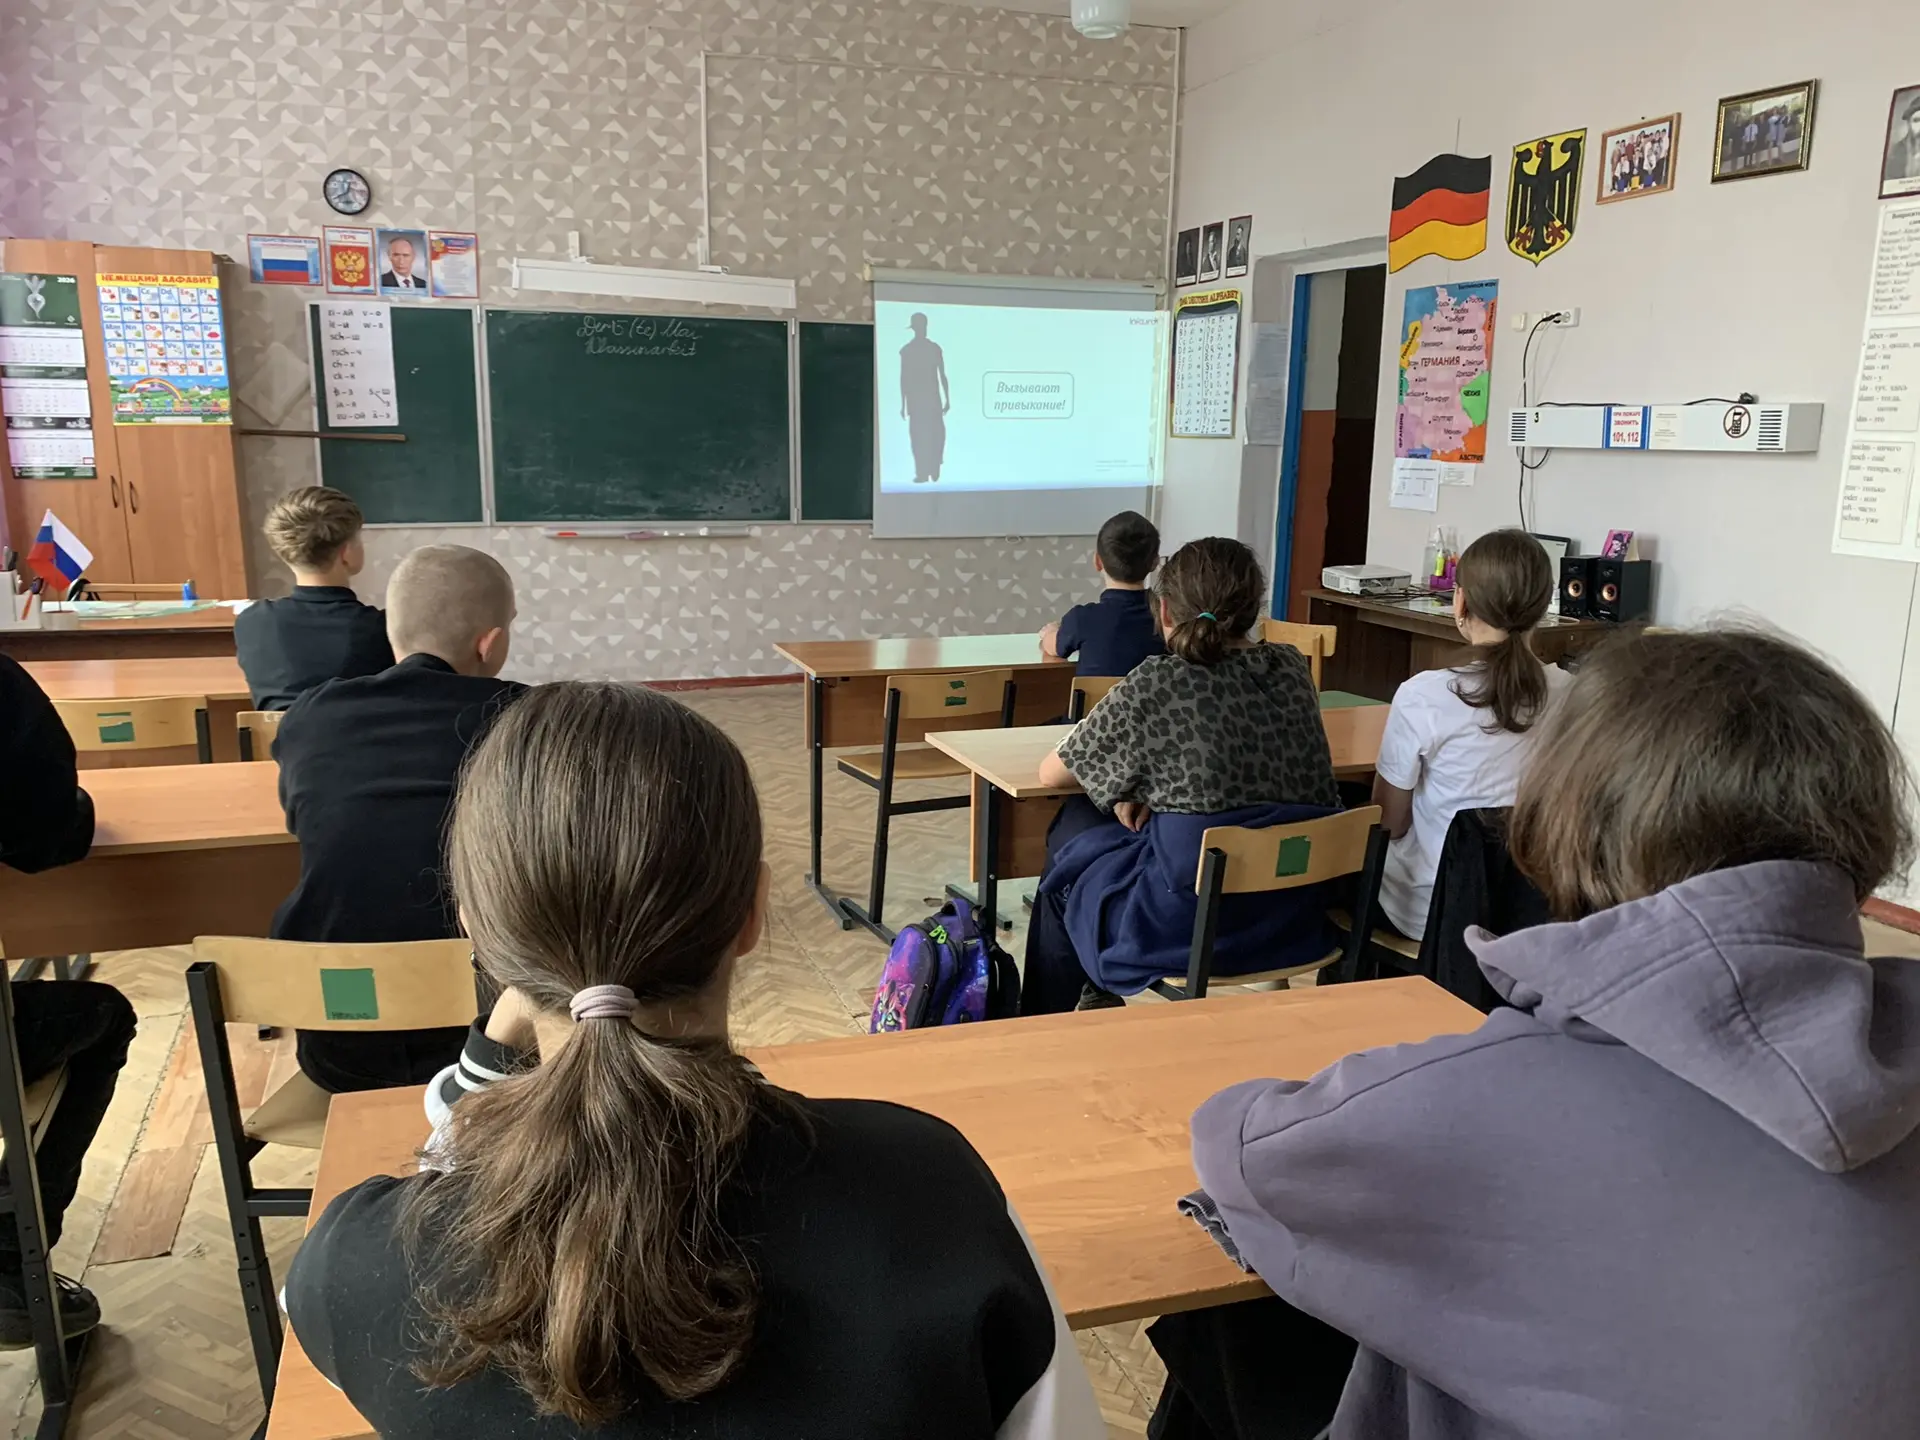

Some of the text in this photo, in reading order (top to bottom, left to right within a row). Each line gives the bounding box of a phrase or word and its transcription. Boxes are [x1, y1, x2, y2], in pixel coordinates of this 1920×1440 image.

[101, 274, 213, 284] НЕМЕЦКИЙ АЛФАВИТ
[585, 336, 697, 356] Klassenarbeit
[1420, 356, 1460, 367] ГЕРМАНИЯ
[997, 381, 1060, 394] Вызывают
[994, 399, 1066, 413] привыкание!
[1534, 412, 1539, 423] 3
[1613, 432, 1639, 443] 101, 112
